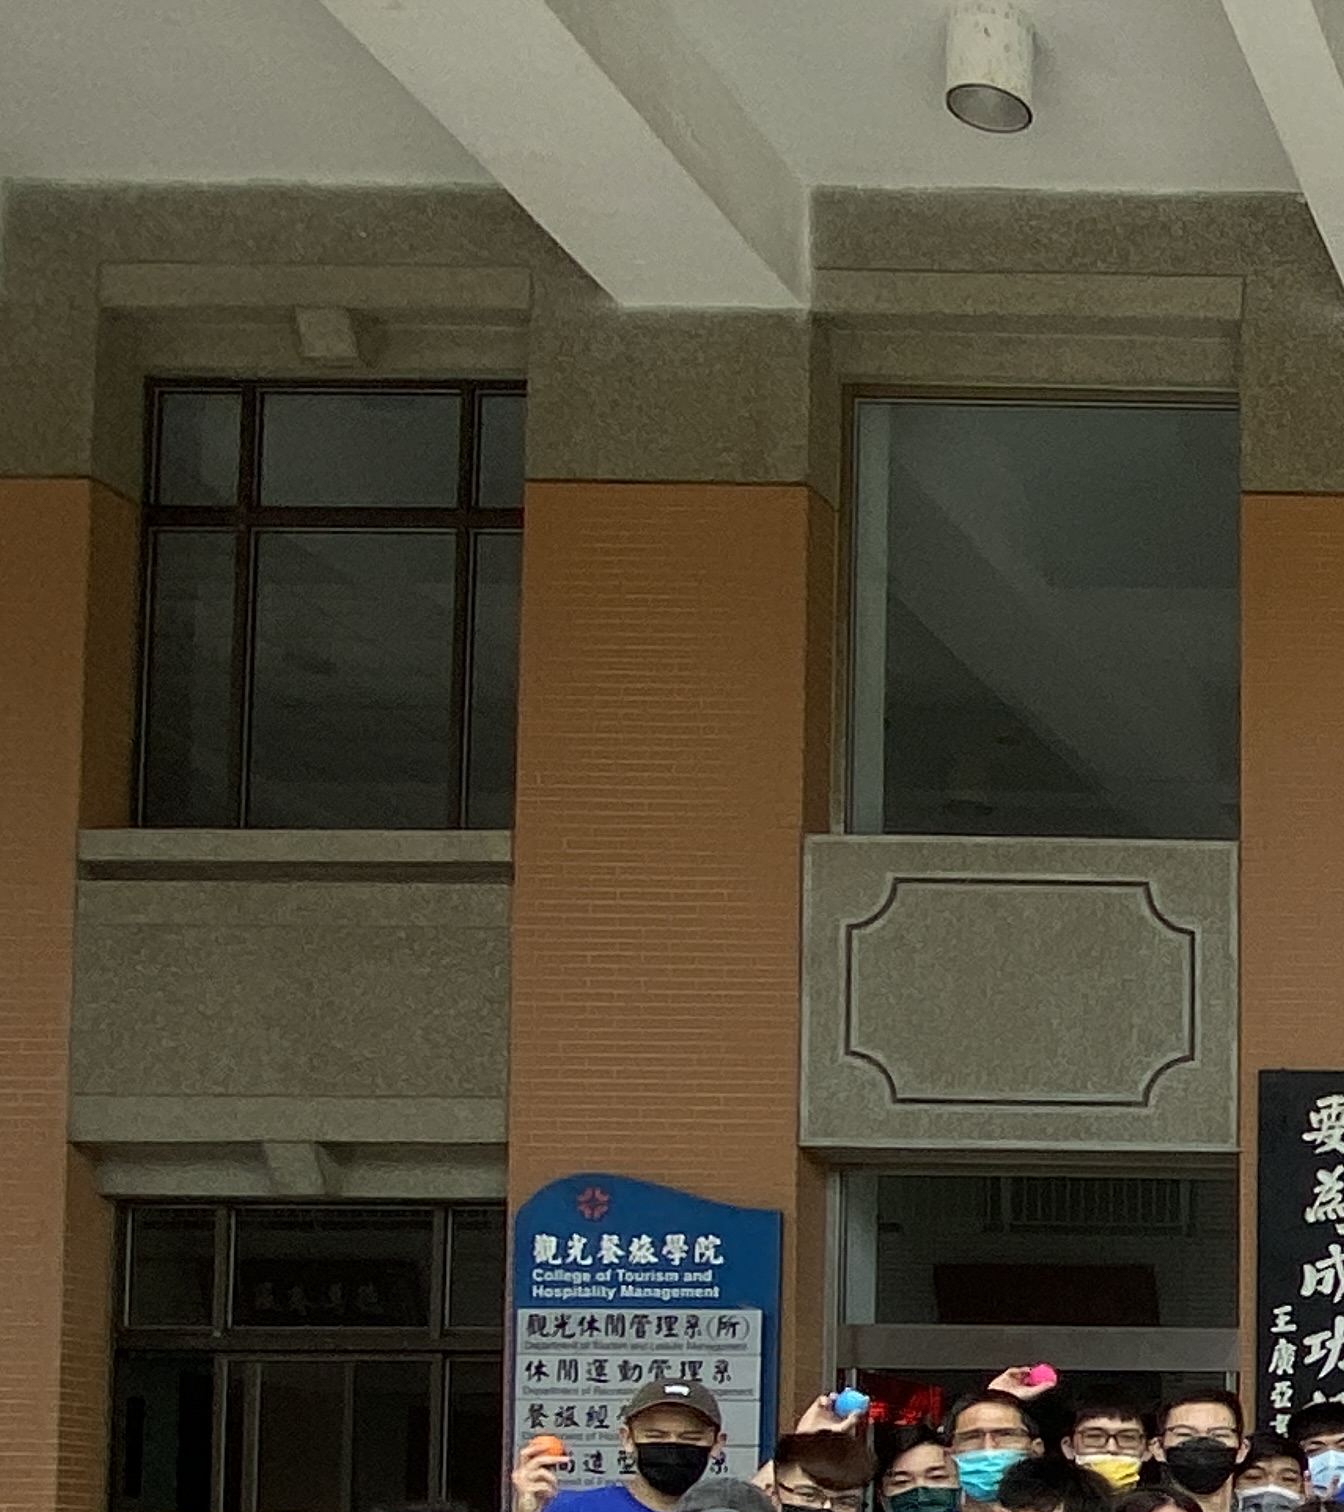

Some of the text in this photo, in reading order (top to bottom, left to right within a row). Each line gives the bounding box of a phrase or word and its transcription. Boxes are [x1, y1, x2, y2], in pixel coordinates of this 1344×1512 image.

[533, 1233, 724, 1266] 觀光餐旅學院
[532, 1269, 713, 1285] College of Tourism and
[532, 1286, 720, 1300] Hospitality Management
